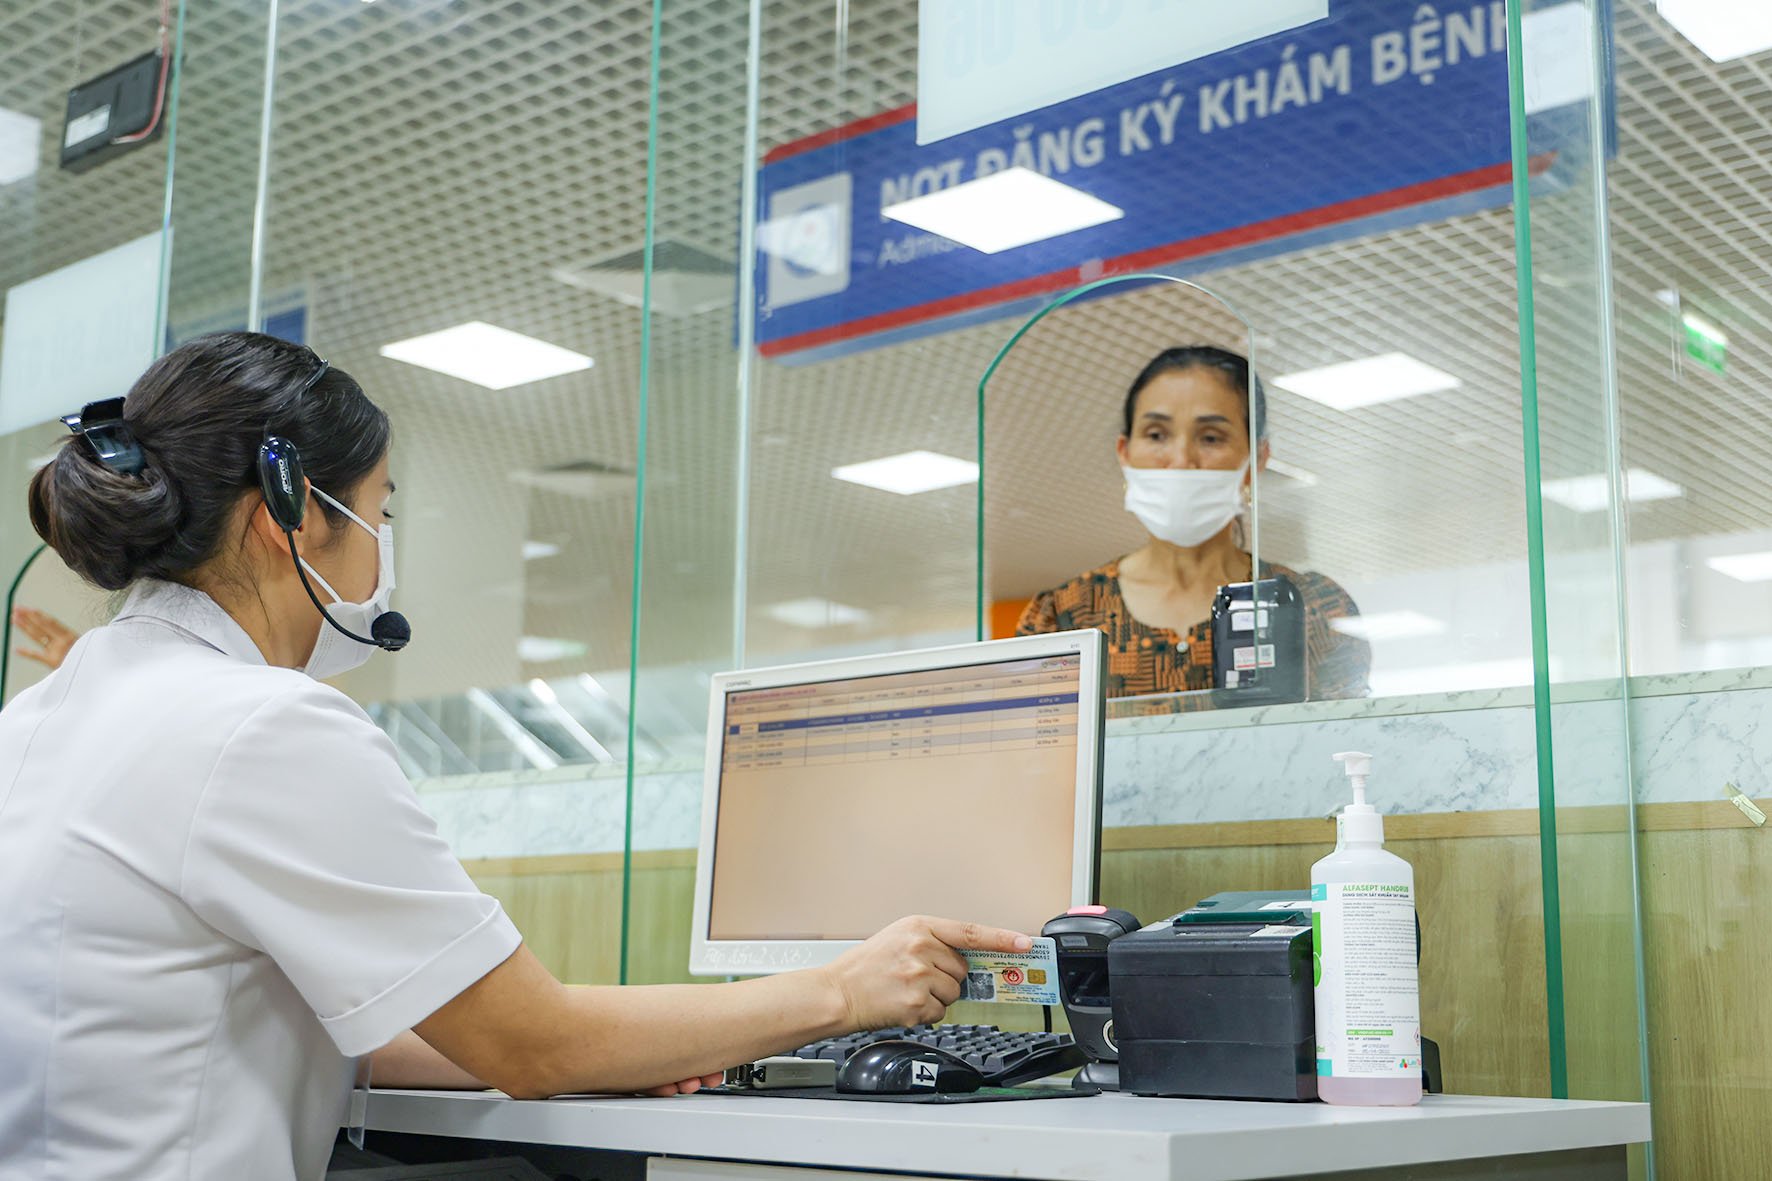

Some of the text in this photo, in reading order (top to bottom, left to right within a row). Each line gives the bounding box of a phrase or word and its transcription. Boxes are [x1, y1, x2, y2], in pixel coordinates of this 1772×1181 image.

[1119, 80, 1186, 156] KÝ
[1199, 45, 1351, 134] KHÁM
[1343, 884, 1378, 892] ALFASEPT
[916, 1065, 935, 1082] 4
